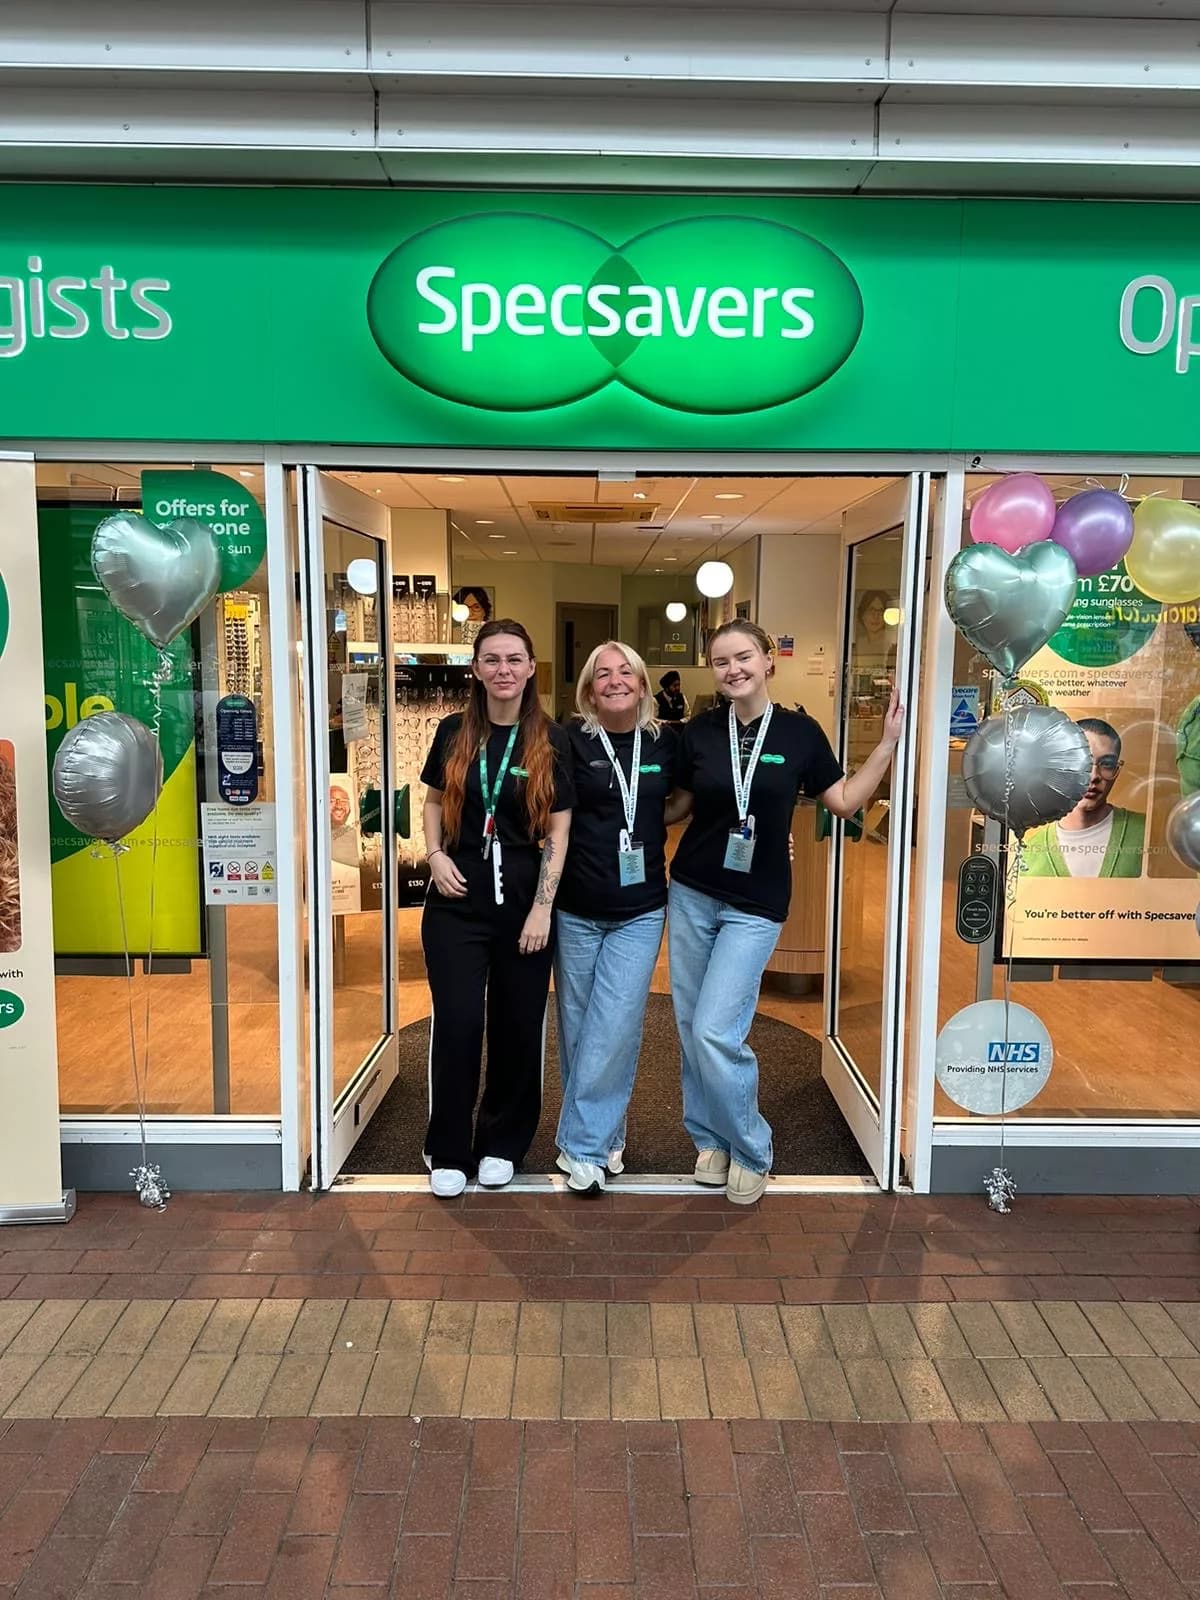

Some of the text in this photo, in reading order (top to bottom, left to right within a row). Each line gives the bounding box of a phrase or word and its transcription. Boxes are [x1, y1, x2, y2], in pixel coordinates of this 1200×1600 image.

[415, 265, 815, 352] Specsavers
[155, 499, 249, 516] Offers for
[227, 544, 252, 554] sun
[1098, 575, 1134, 592] £70
[1090, 597, 1143, 608] sunglasses
[1056, 679, 1085, 688] better,
[1055, 689, 1091, 697] weather
[1025, 909, 1058, 919] You're
[1061, 909, 1096, 919] better
[1098, 909, 1115, 919] off
[1118, 910, 1142, 920] with
[989, 1044, 1038, 1061] NHS
[947, 1065, 986, 1075] Providing
